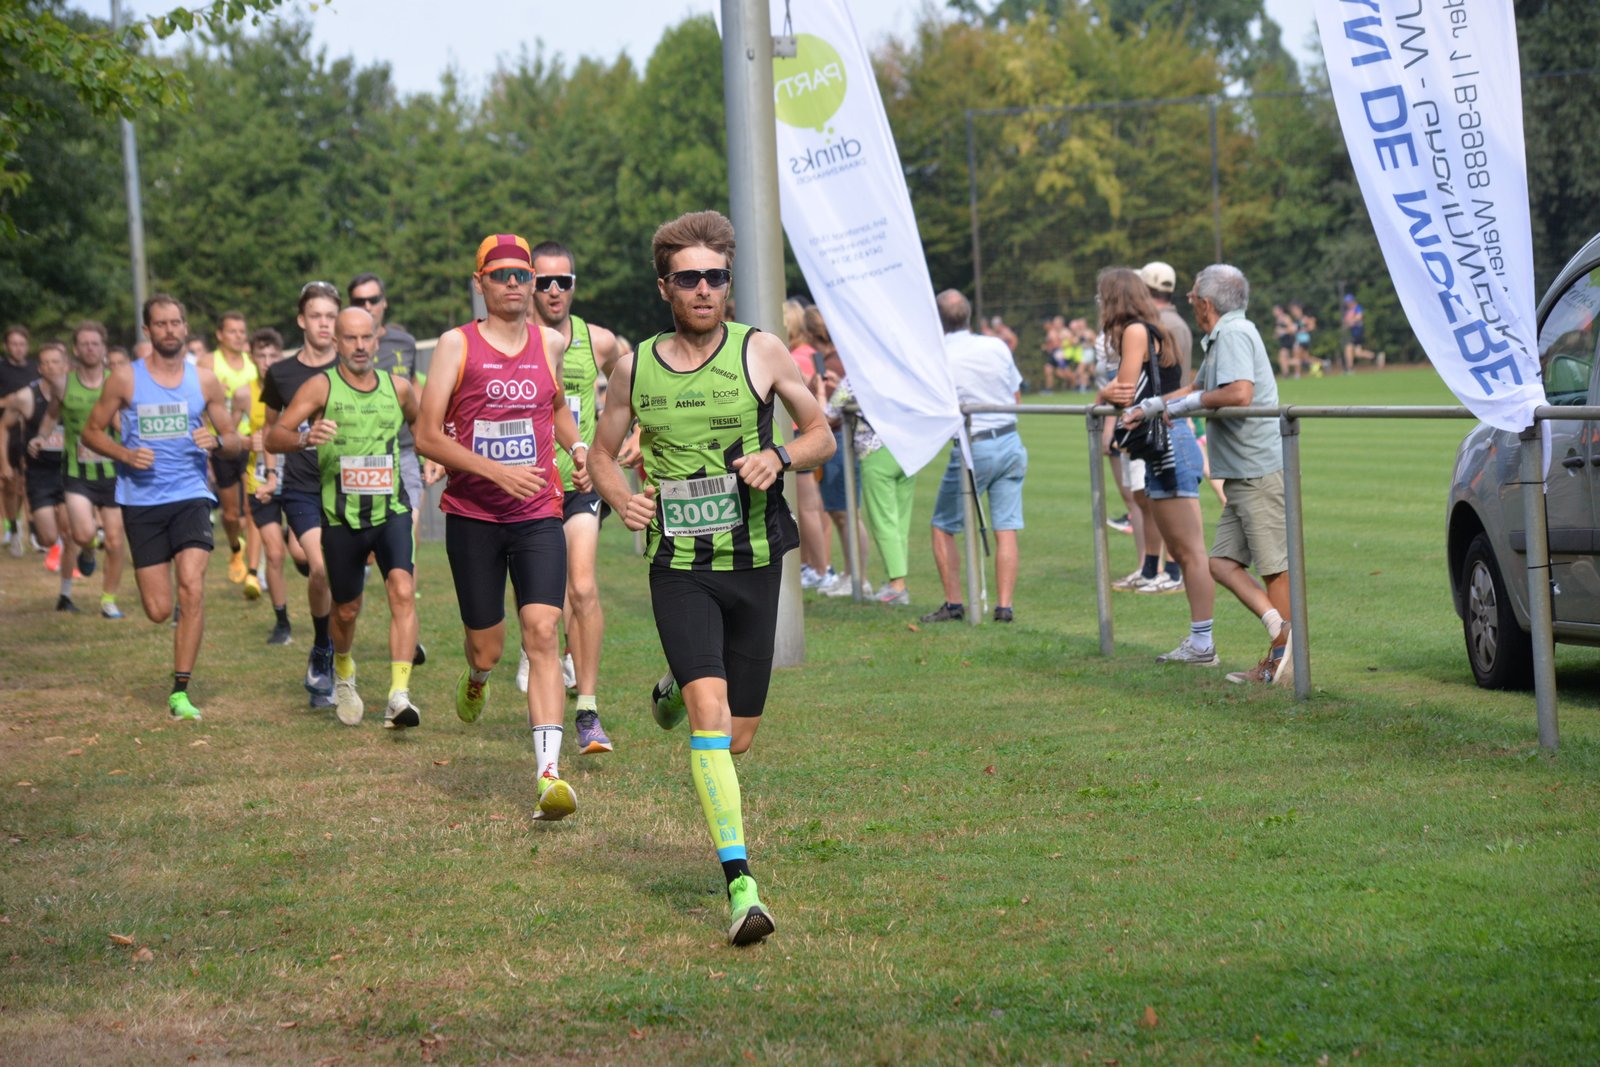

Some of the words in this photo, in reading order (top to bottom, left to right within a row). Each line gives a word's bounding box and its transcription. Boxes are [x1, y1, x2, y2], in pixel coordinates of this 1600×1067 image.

[711, 366, 738, 381] BIORACER
[712, 388, 739, 398] boost
[675, 400, 706, 409] Athlex
[142, 416, 186, 433] 3026
[712, 417, 739, 426] FIESIEK
[477, 438, 534, 460] 1066
[345, 469, 392, 486] 2024
[668, 498, 738, 525] 3002
